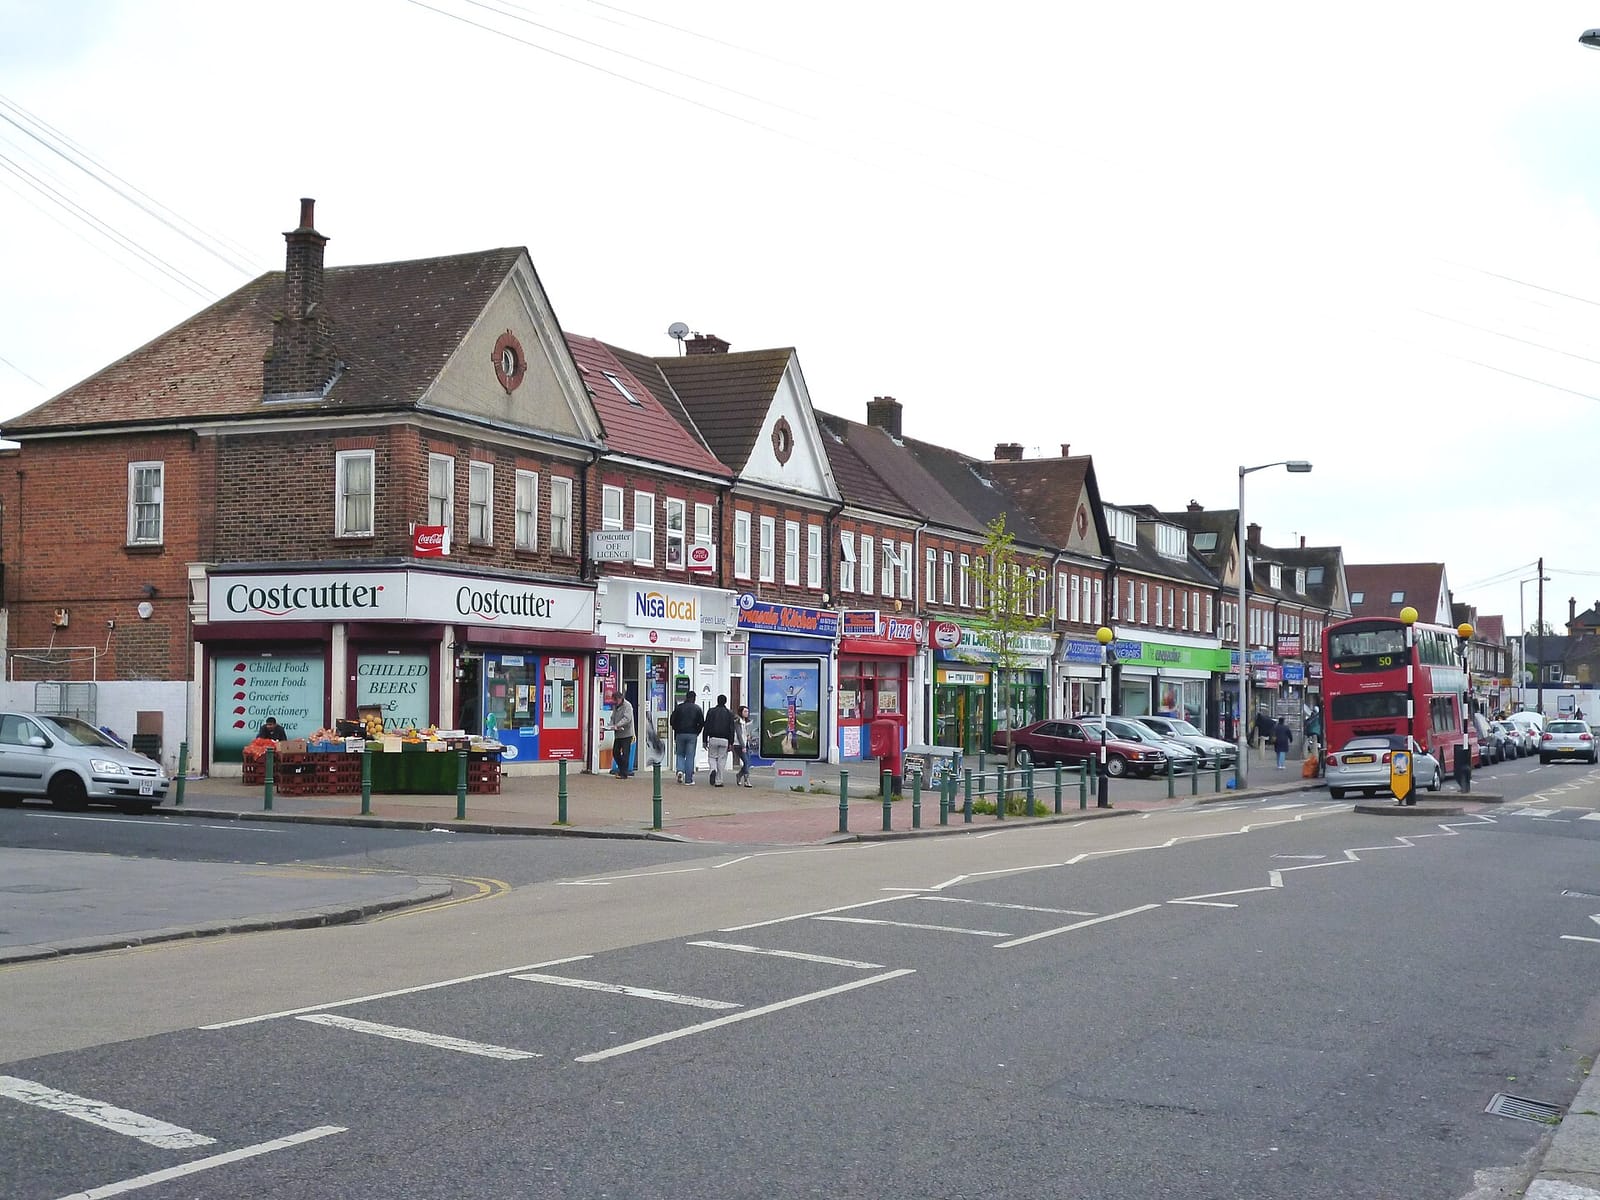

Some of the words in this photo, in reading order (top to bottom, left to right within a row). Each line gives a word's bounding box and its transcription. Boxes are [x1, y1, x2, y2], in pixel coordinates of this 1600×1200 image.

[418, 533, 443, 545] Coca-Cola
[597, 533, 631, 541] Costcutter
[226, 582, 385, 614] Costcutter
[456, 586, 555, 619] Costcutter
[636, 591, 665, 618] Nisa
[666, 595, 696, 621] local
[1379, 656, 1392, 666] 50
[249, 662, 282, 673] Chilled
[284, 662, 310, 673] Foods
[358, 664, 428, 677] CHILLED
[250, 677, 279, 687] Frozen
[281, 677, 307, 687] Foods
[368, 682, 418, 694] BEERS
[248, 691, 290, 702] Groceries
[248, 705, 309, 719] Confectionery
[388, 700, 399, 712] &
[383, 718, 418, 729] INES
